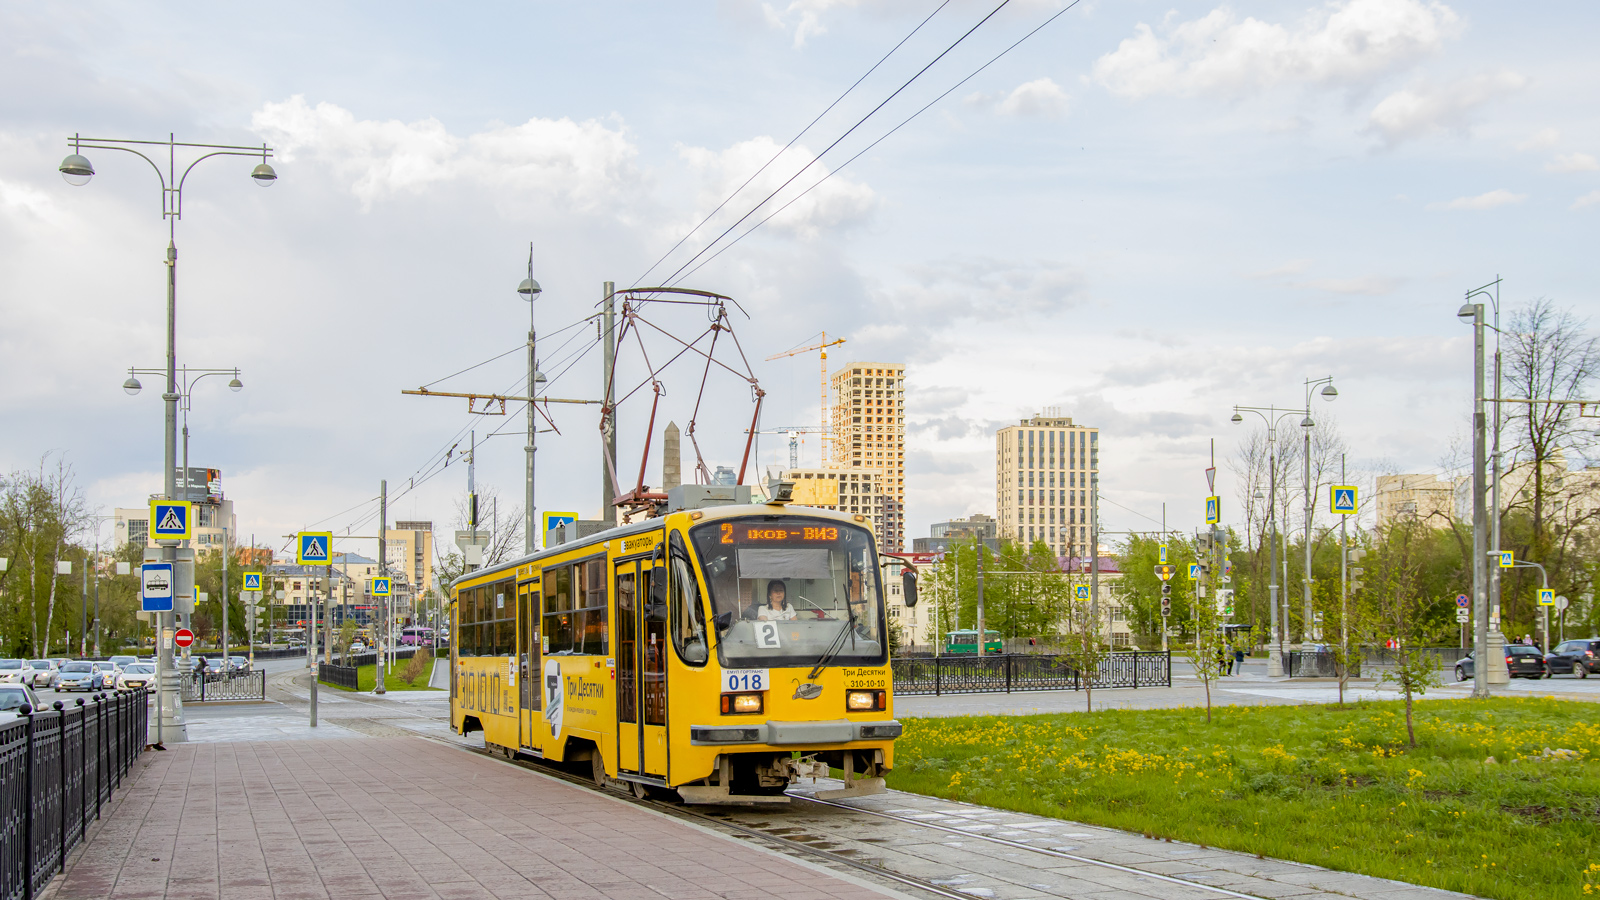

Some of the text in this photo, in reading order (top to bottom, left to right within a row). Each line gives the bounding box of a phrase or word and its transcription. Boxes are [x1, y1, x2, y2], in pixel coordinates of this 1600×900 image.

[721, 522, 733, 544] 2
[803, 527, 838, 540] ВИЗ
[762, 624, 777, 646] 2
[729, 674, 762, 690] 018
[842, 668, 886, 677] Три Десятки
[566, 675, 604, 701] Три Десятки
[850, 680, 885, 688] 310-10-10
